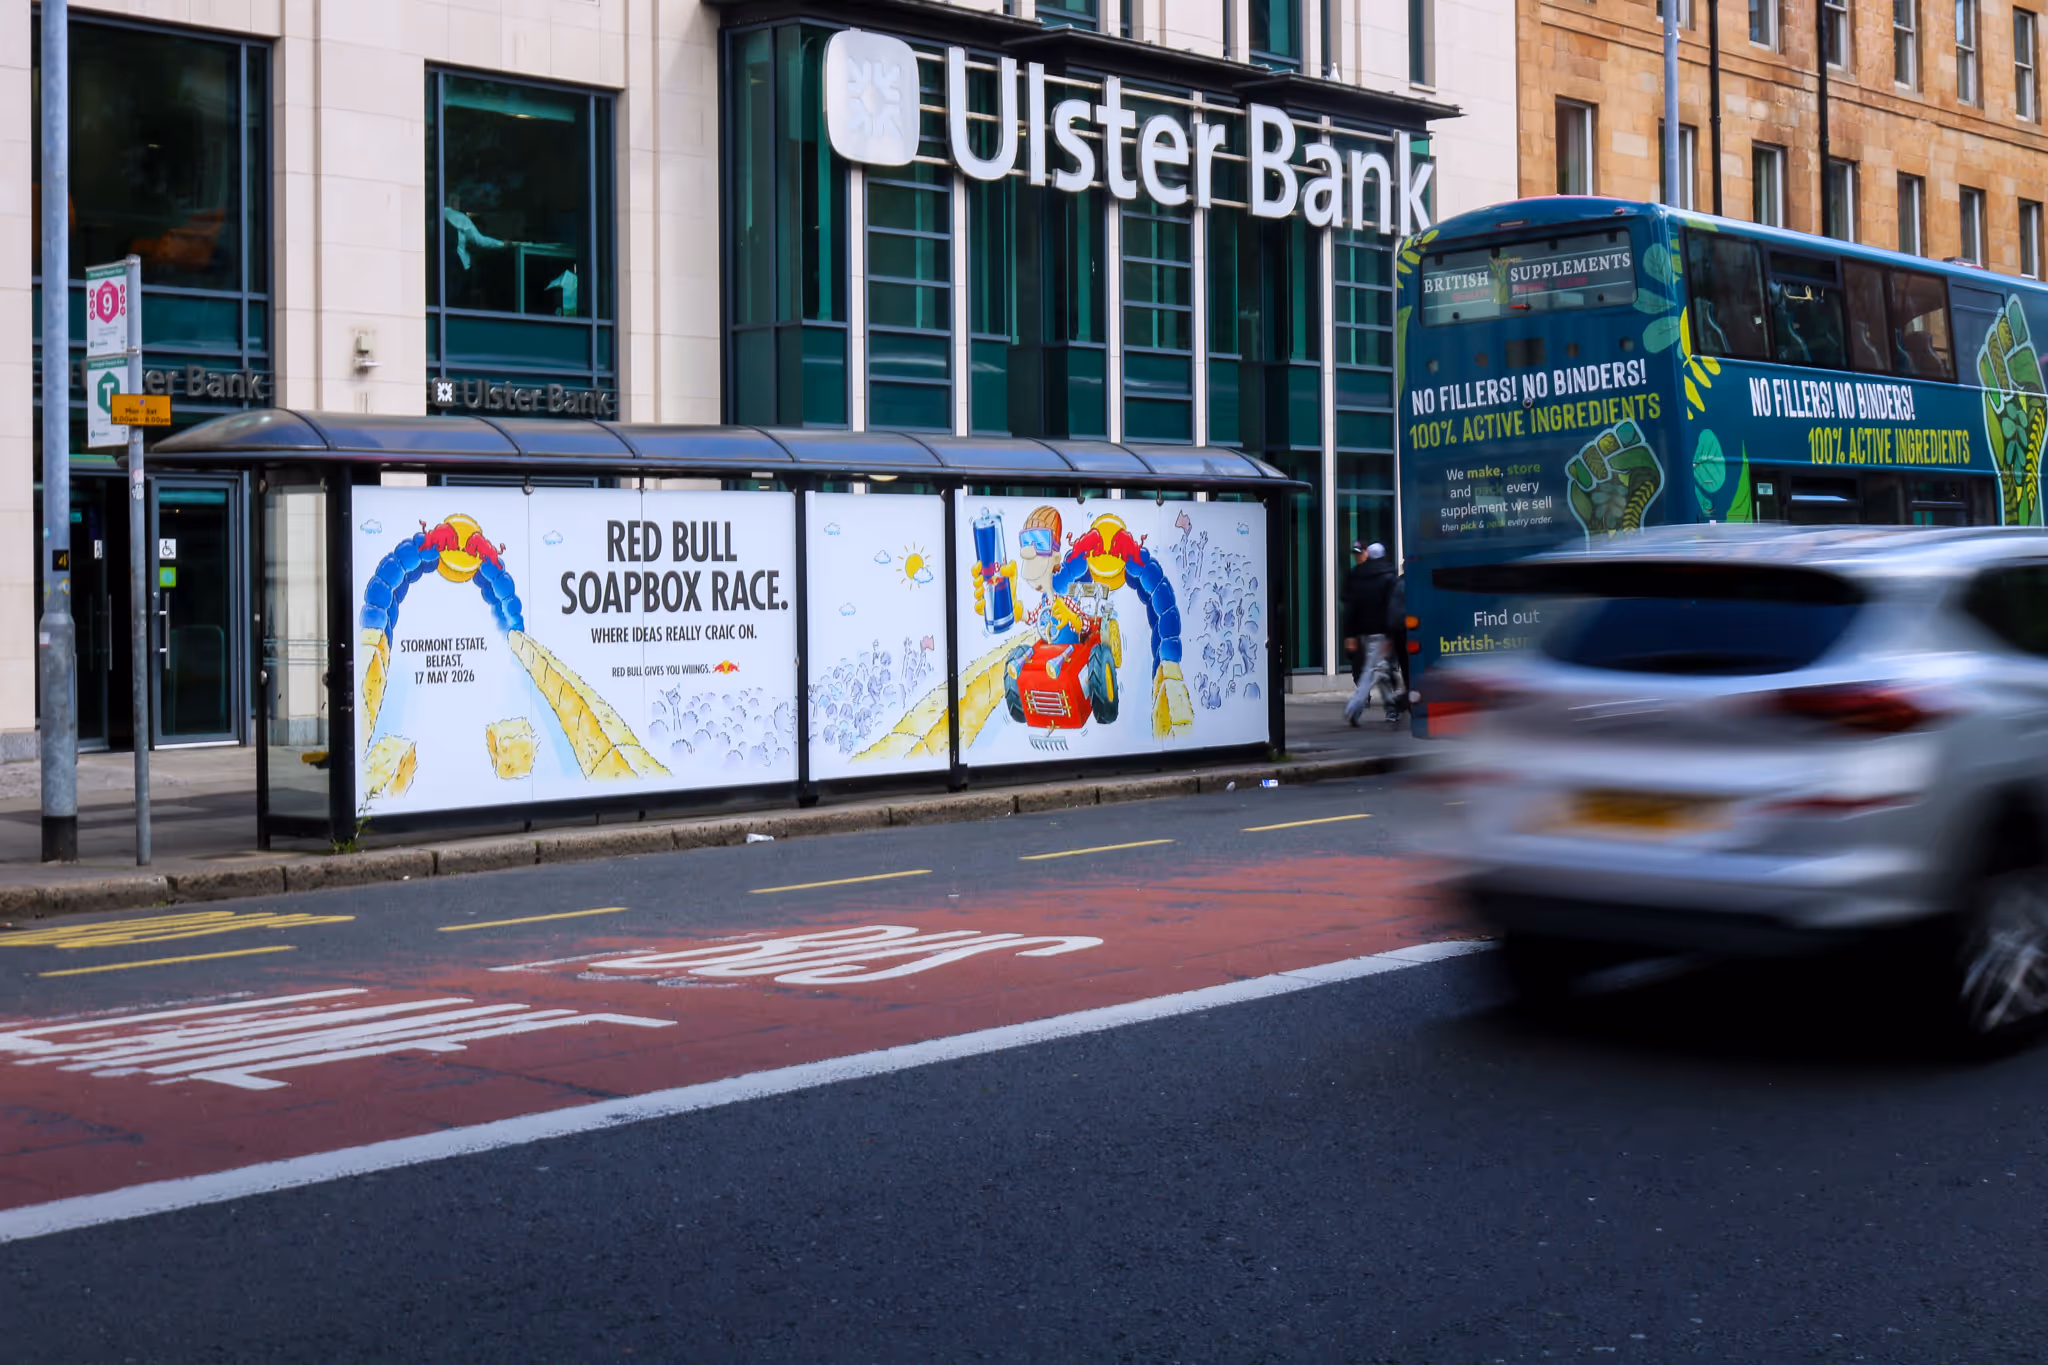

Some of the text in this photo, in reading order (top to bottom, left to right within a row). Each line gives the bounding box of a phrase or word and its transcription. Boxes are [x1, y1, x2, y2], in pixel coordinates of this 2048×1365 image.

[945, 46, 1436, 236] Ulster Bank
[1423, 271, 1489, 294] BRITISH
[1510, 252, 1631, 282] SUPPLEMENTS
[103, 293, 113, 315] 9
[187, 363, 265, 400] Bank
[1411, 358, 1647, 416] NO FILLERS! NO BINDERS!
[102, 382, 115, 407] T
[461, 378, 612, 415] Ulster Bank
[1749, 377, 1916, 421] NO FILLERS! NO BINDERS!
[1409, 392, 1661, 449] 100% ACTIVE INGREDIENTS
[1808, 427, 1970, 464] 100% ACTIVE INGREDIENTS
[1446, 464, 1540, 481] We make, store
[1450, 485, 1471, 498] and
[1506, 482, 1539, 494] every
[1441, 496, 1552, 519] supplement we sell
[1442, 523, 1458, 532] then
[1460, 521, 1477, 532] pick
[1479, 520, 1484, 529] &
[1507, 518, 1529, 528] every
[607, 520, 737, 562] RED BULL
[560, 570, 789, 614] SOAPBOX RACE.
[1474, 608, 1541, 627] Find out
[400, 637, 487, 653] STORMONT ESTATE,
[591, 624, 758, 643] WHERE IDEAS REALLY CRAIC ON.
[426, 653, 463, 668] BELFAST,
[612, 666, 625, 677] RED
[627, 666, 643, 677] BULL
[644, 665, 664, 677] GIVES
[666, 664, 680, 676] YOU
[415, 669, 475, 685] 17 MAY 2026
